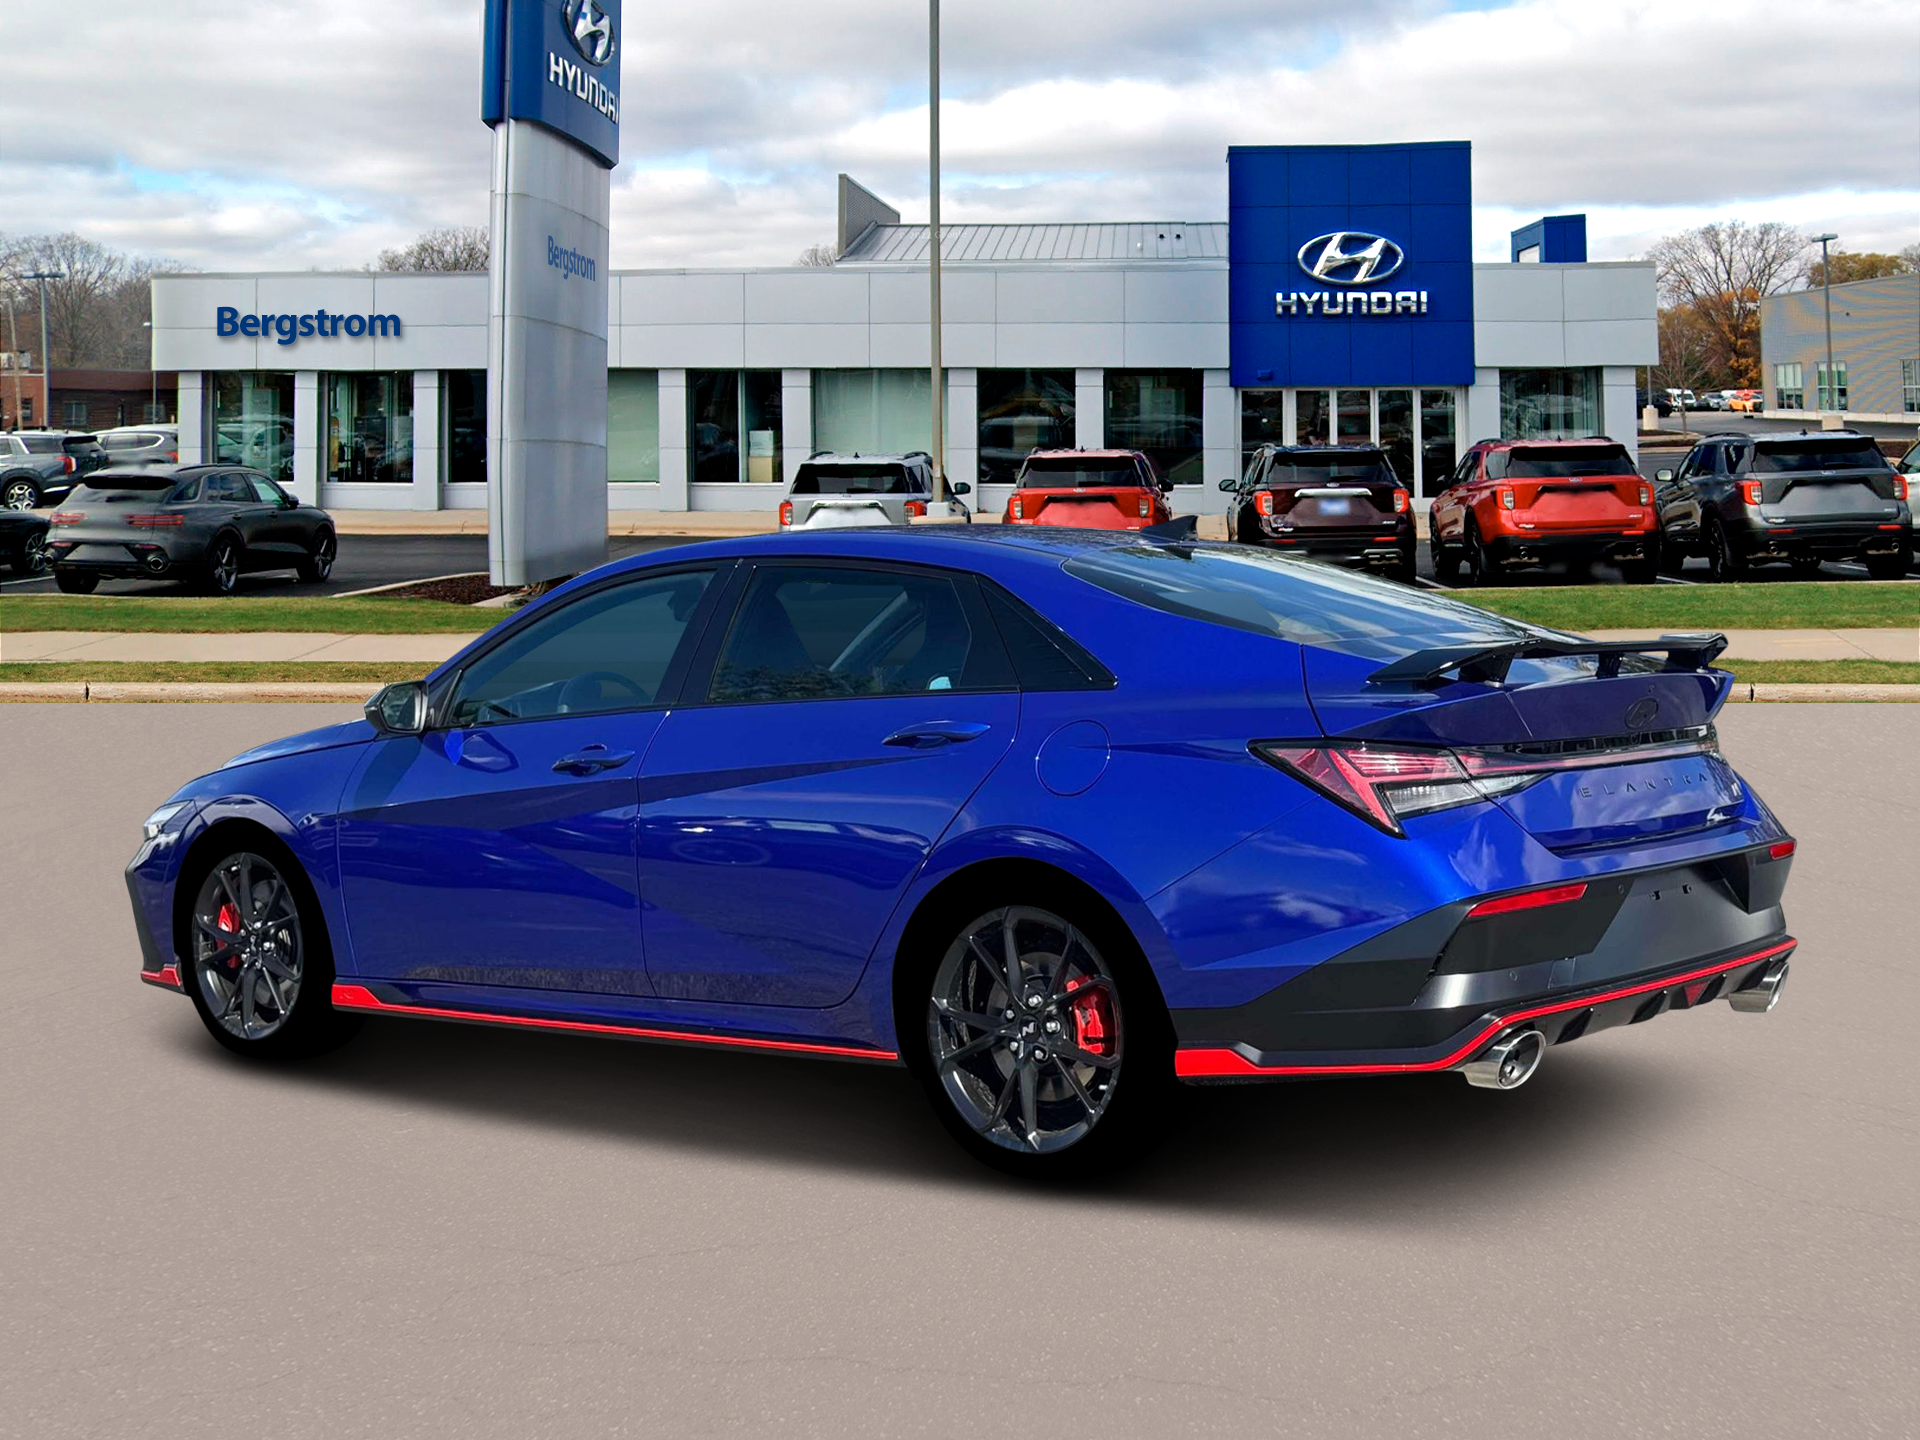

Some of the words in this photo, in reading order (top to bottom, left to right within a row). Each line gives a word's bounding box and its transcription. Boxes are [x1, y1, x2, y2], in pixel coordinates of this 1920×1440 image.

[548, 51, 619, 125] HYUNDAI
[547, 235, 596, 282] Bergstrom
[1275, 290, 1428, 316] HYUNDAI
[216, 306, 402, 346] Bergstrom
[1579, 772, 1708, 799] ELANTRA
